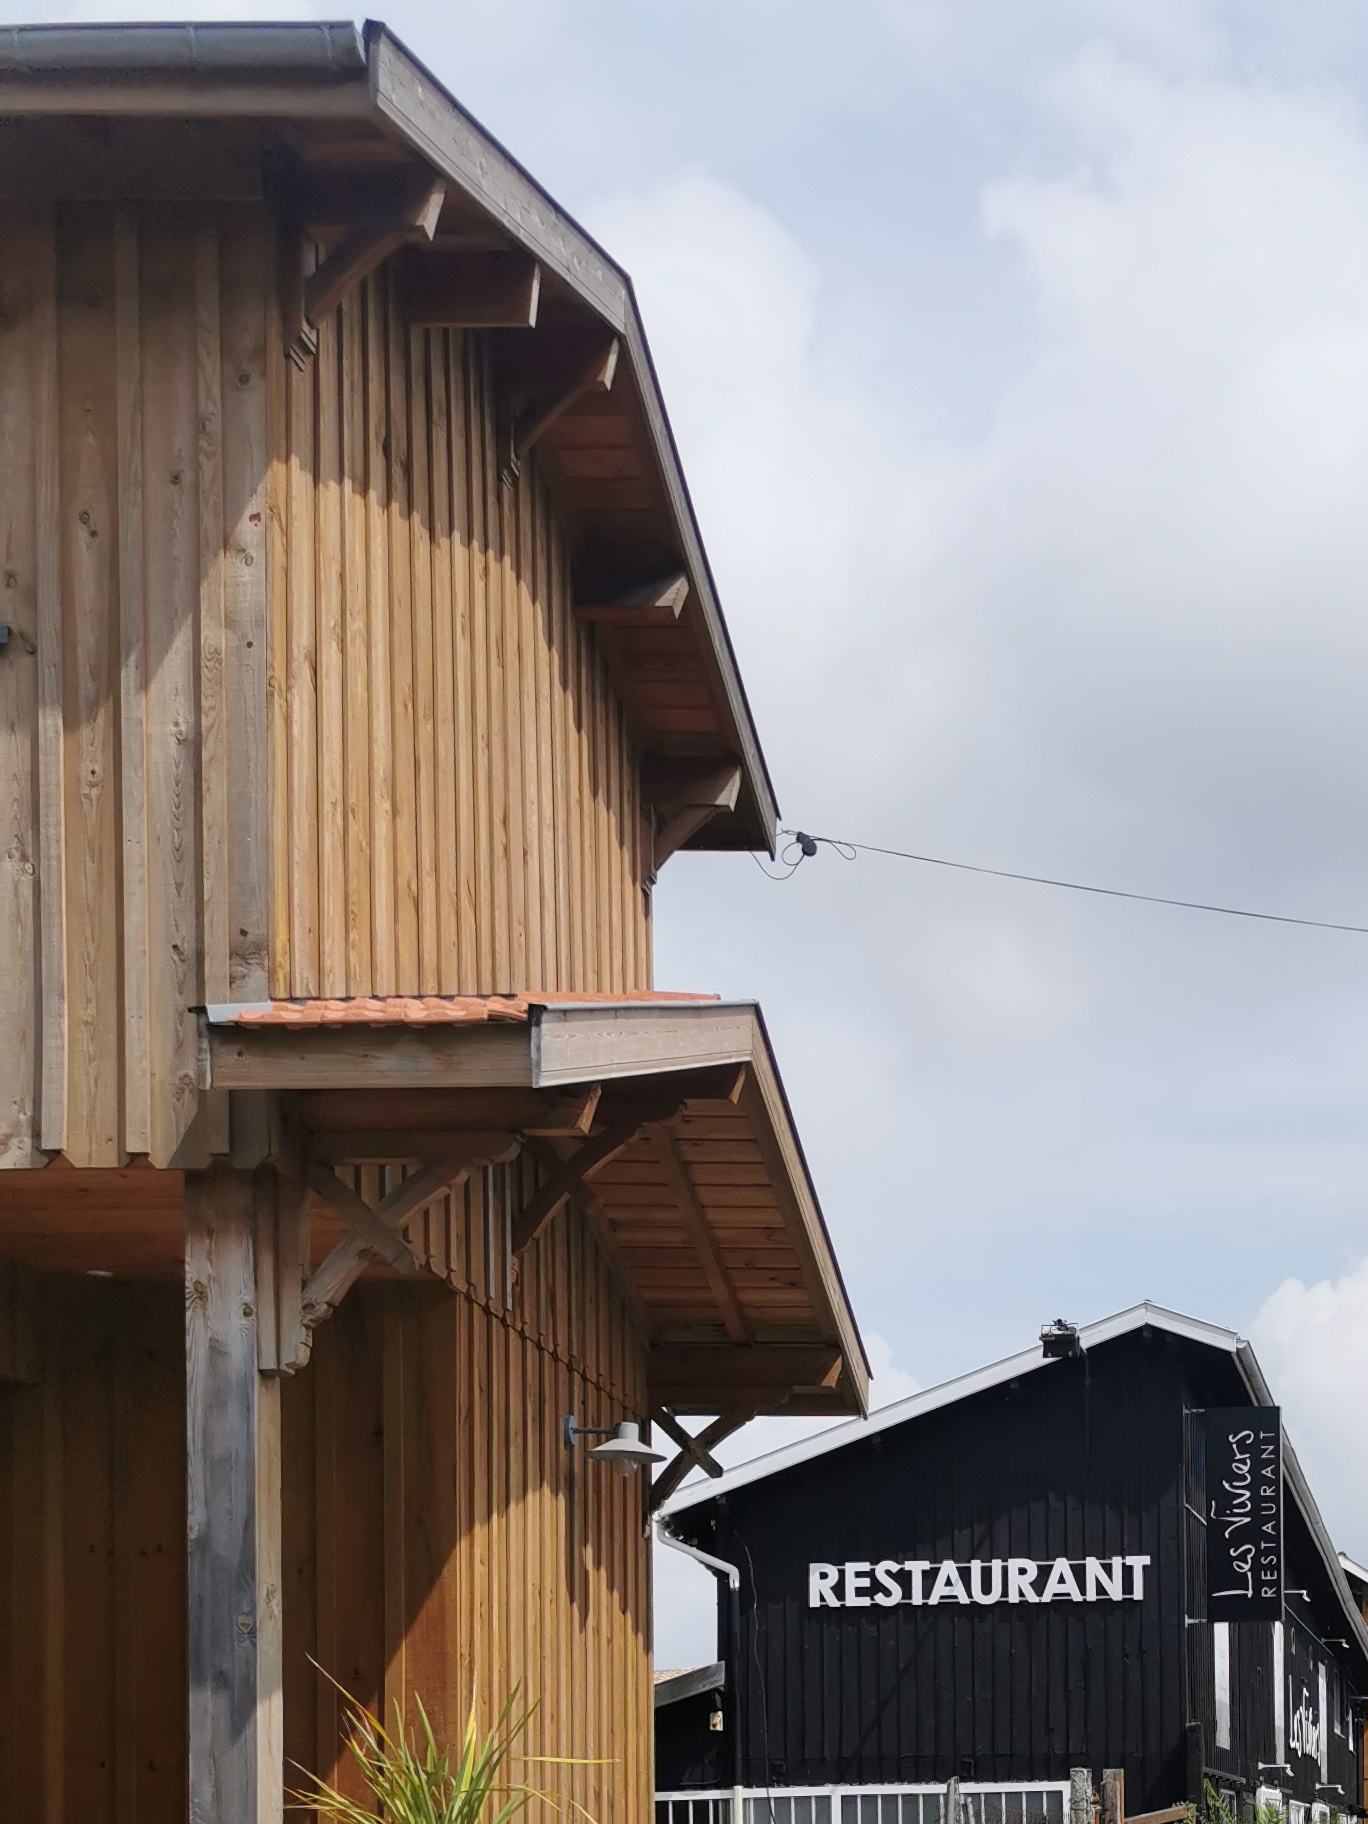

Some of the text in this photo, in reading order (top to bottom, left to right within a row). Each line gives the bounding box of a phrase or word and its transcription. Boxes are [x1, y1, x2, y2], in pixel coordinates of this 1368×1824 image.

[810, 1555, 1150, 1608] RESTAURANT
[1210, 1430, 1255, 1598] Les Viviers
[1260, 1430, 1277, 1598] RESTAURANT
